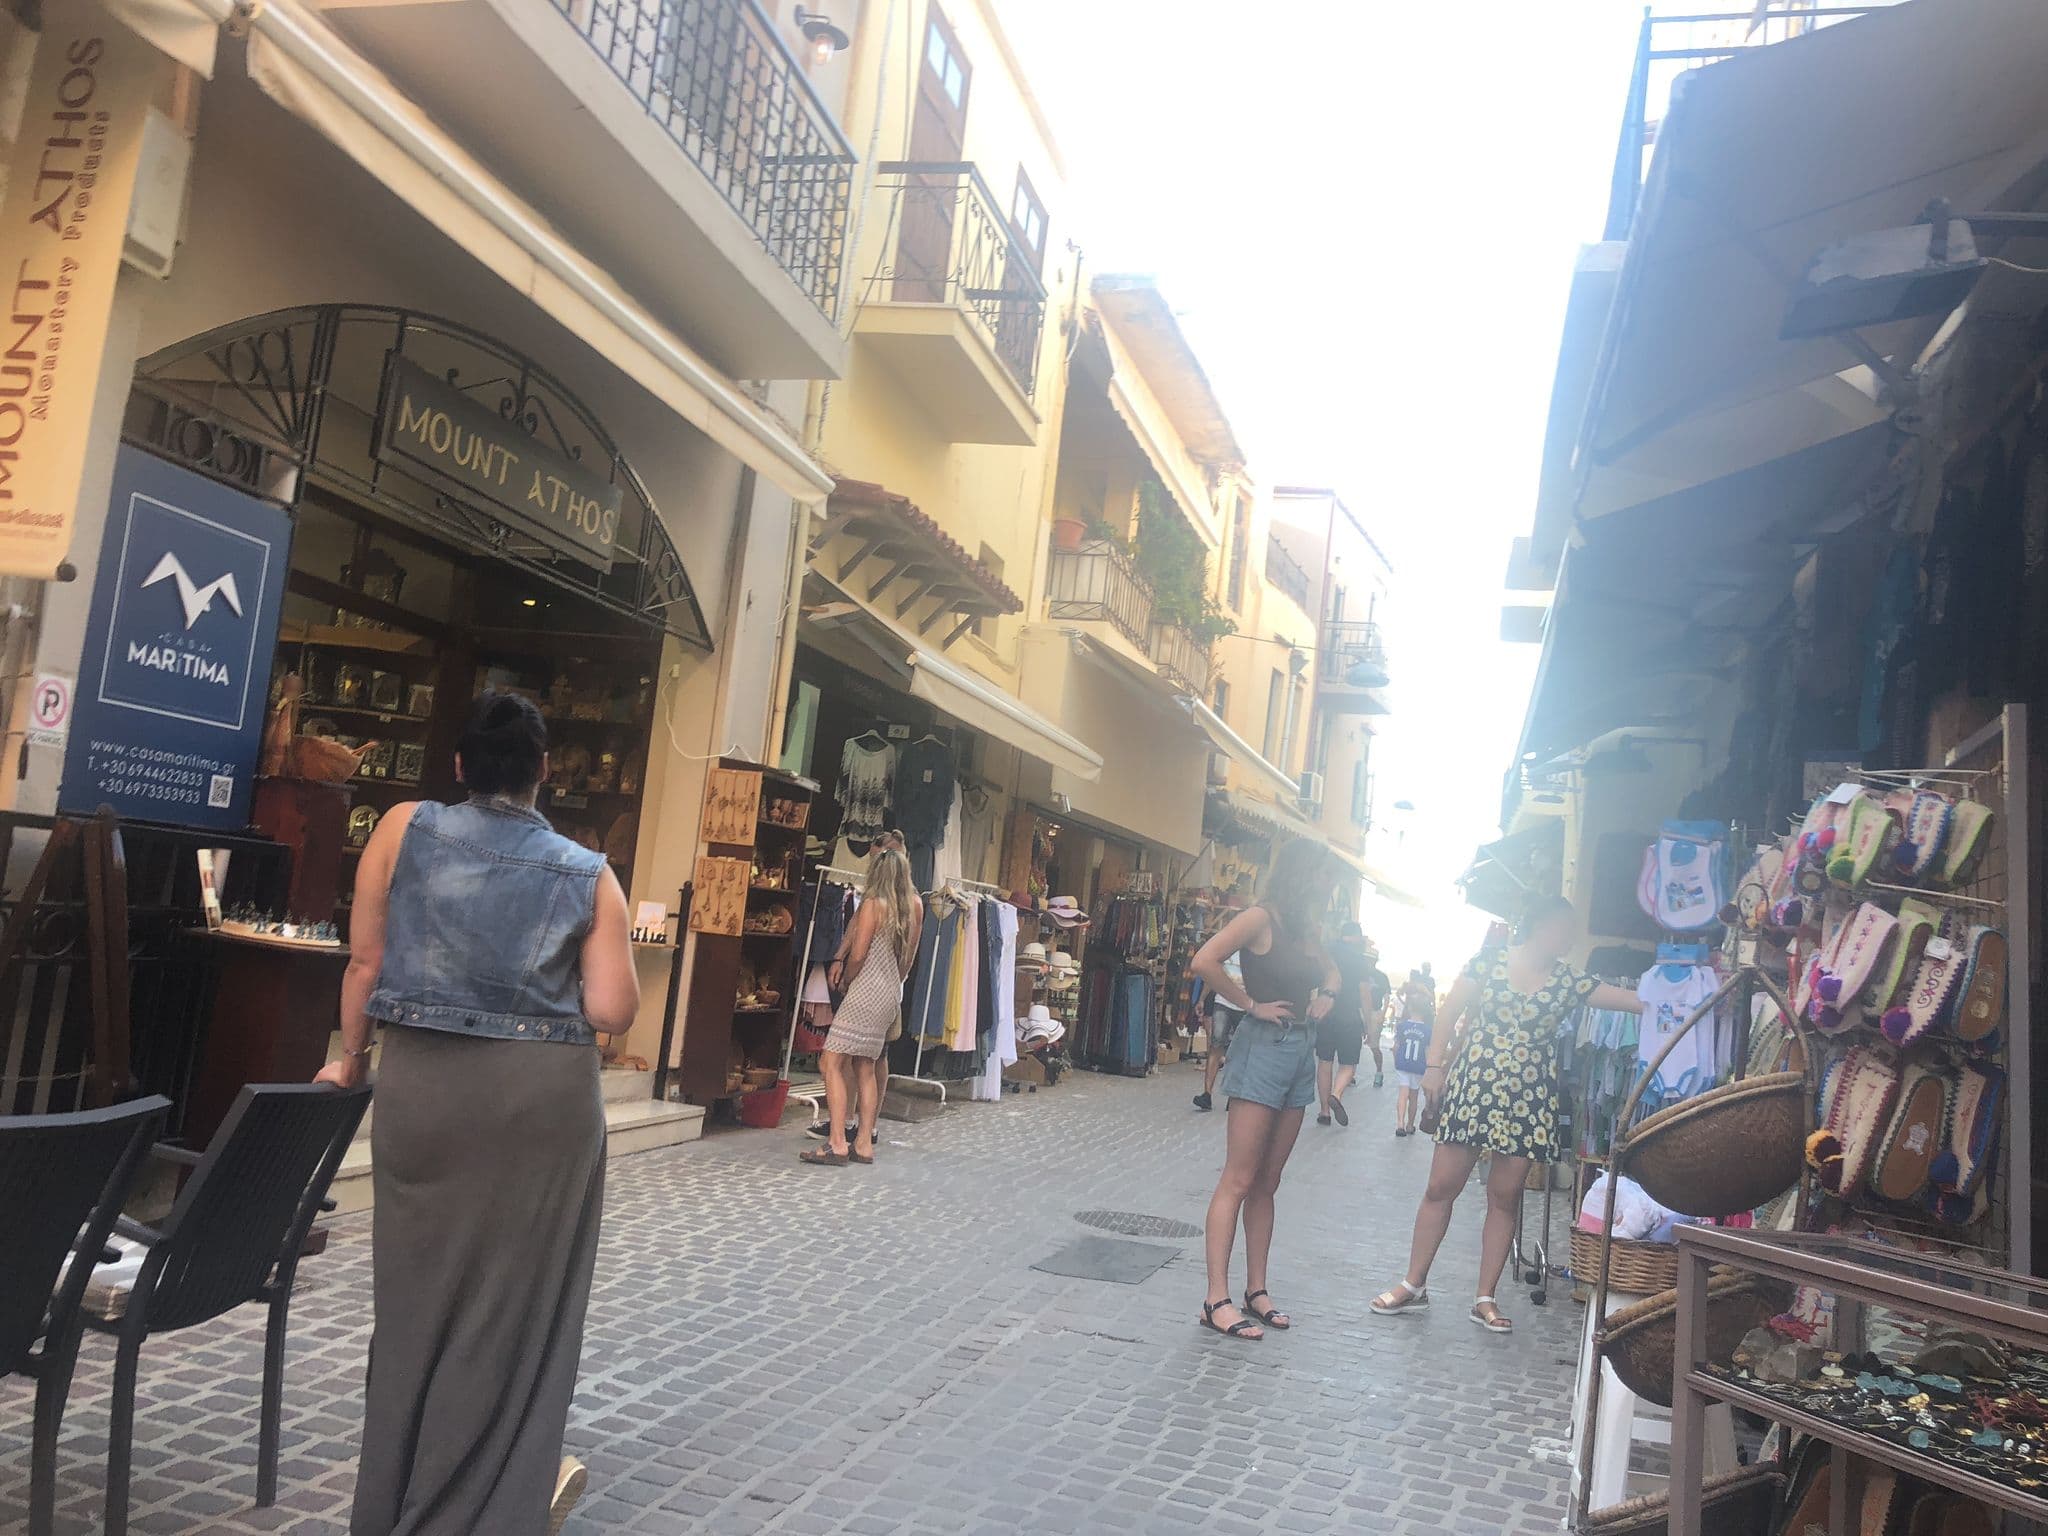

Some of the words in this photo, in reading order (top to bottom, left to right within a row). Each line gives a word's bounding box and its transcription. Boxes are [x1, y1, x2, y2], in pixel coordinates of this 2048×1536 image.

[28, 37, 104, 233] ATHOS
[29, 256, 79, 421] Monastery
[61, 110, 109, 240] Products
[398, 395, 519, 486] MOUNT
[527, 470, 616, 545] ATHOS
[89, 738, 236, 776] www.casamaritima.gr
[1405, 1039, 1420, 1061] 11
